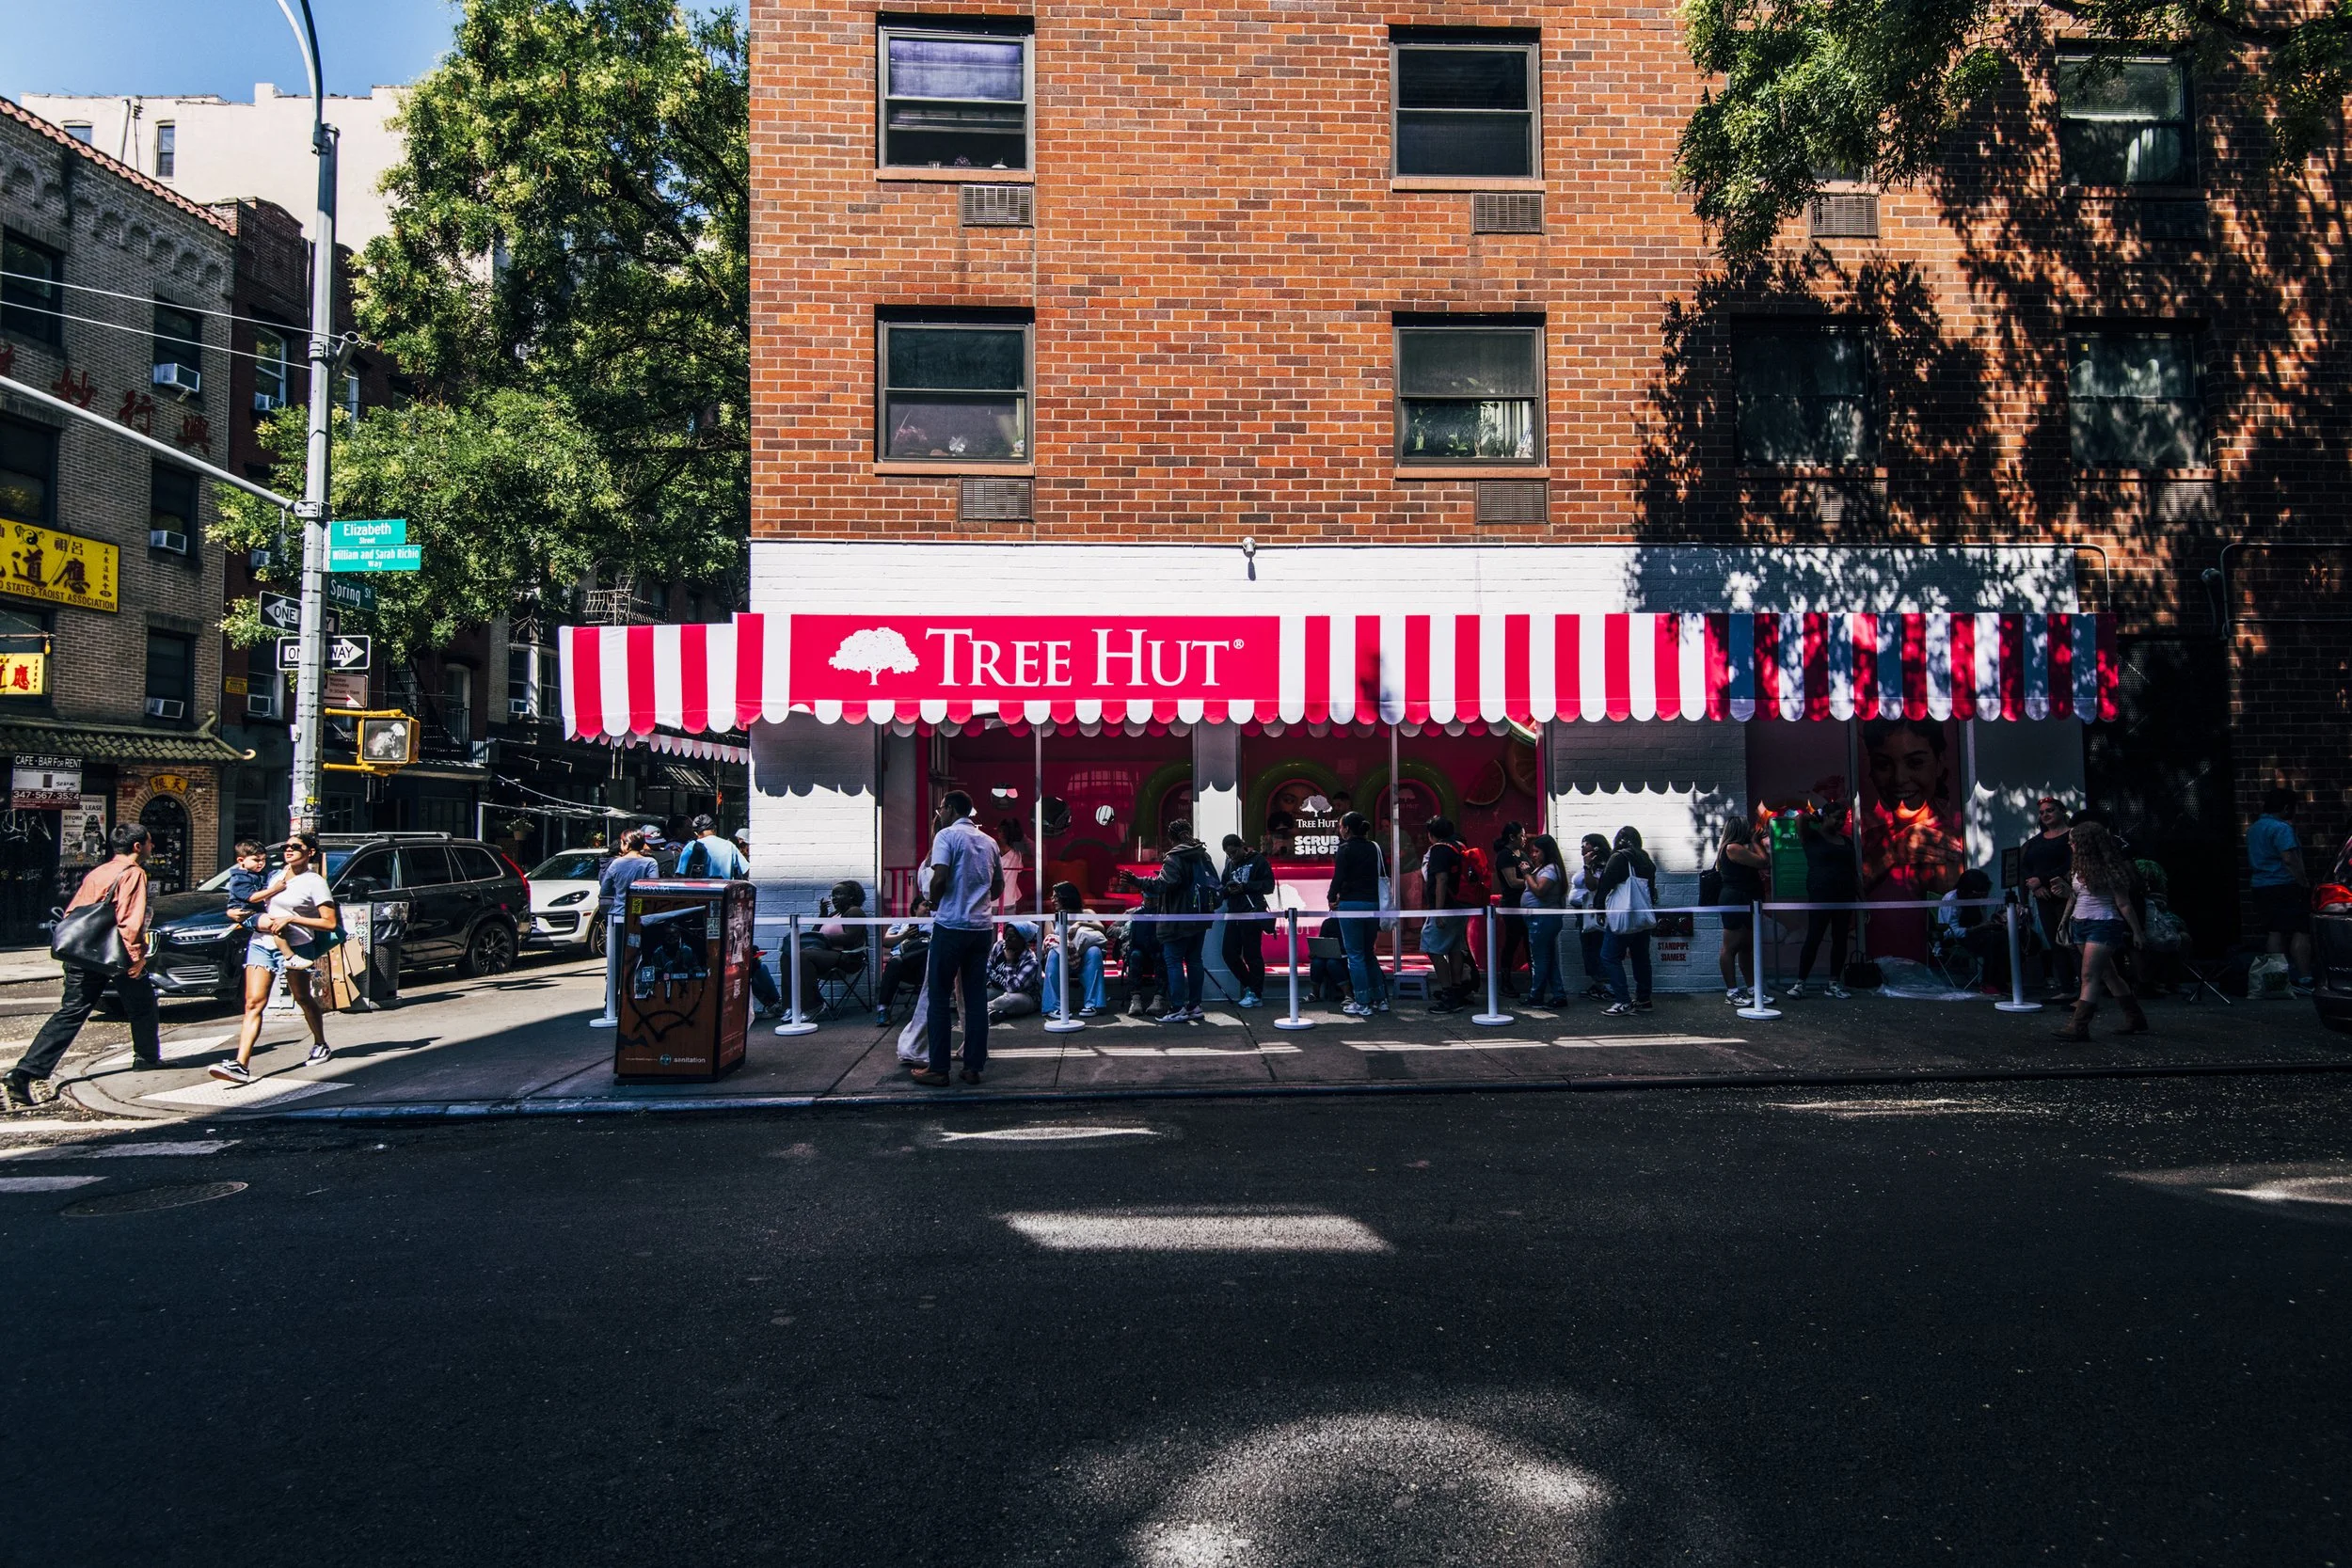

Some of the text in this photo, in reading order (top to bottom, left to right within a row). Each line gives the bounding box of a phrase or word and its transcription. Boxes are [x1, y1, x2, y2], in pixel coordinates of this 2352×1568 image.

[343, 523, 391, 536] Elizabeth
[332, 548, 419, 561] William and Sarah Richio
[7, 581, 36, 595] STATES
[39, 588, 64, 601] TAOIST
[67, 595, 115, 610] ASSOCIATION
[330, 579, 372, 607] Spring St
[274, 605, 296, 622] ONE
[329, 646, 354, 658] WAY
[925, 627, 1073, 687] TREE
[15, 755, 34, 766] CAFE
[39, 756, 53, 767] BAR
[65, 759, 82, 768] RENT
[1295, 818, 1316, 828] TREE
[1294, 835, 1341, 846] SCRUB
[1661, 953, 1687, 961] SIAMESE
